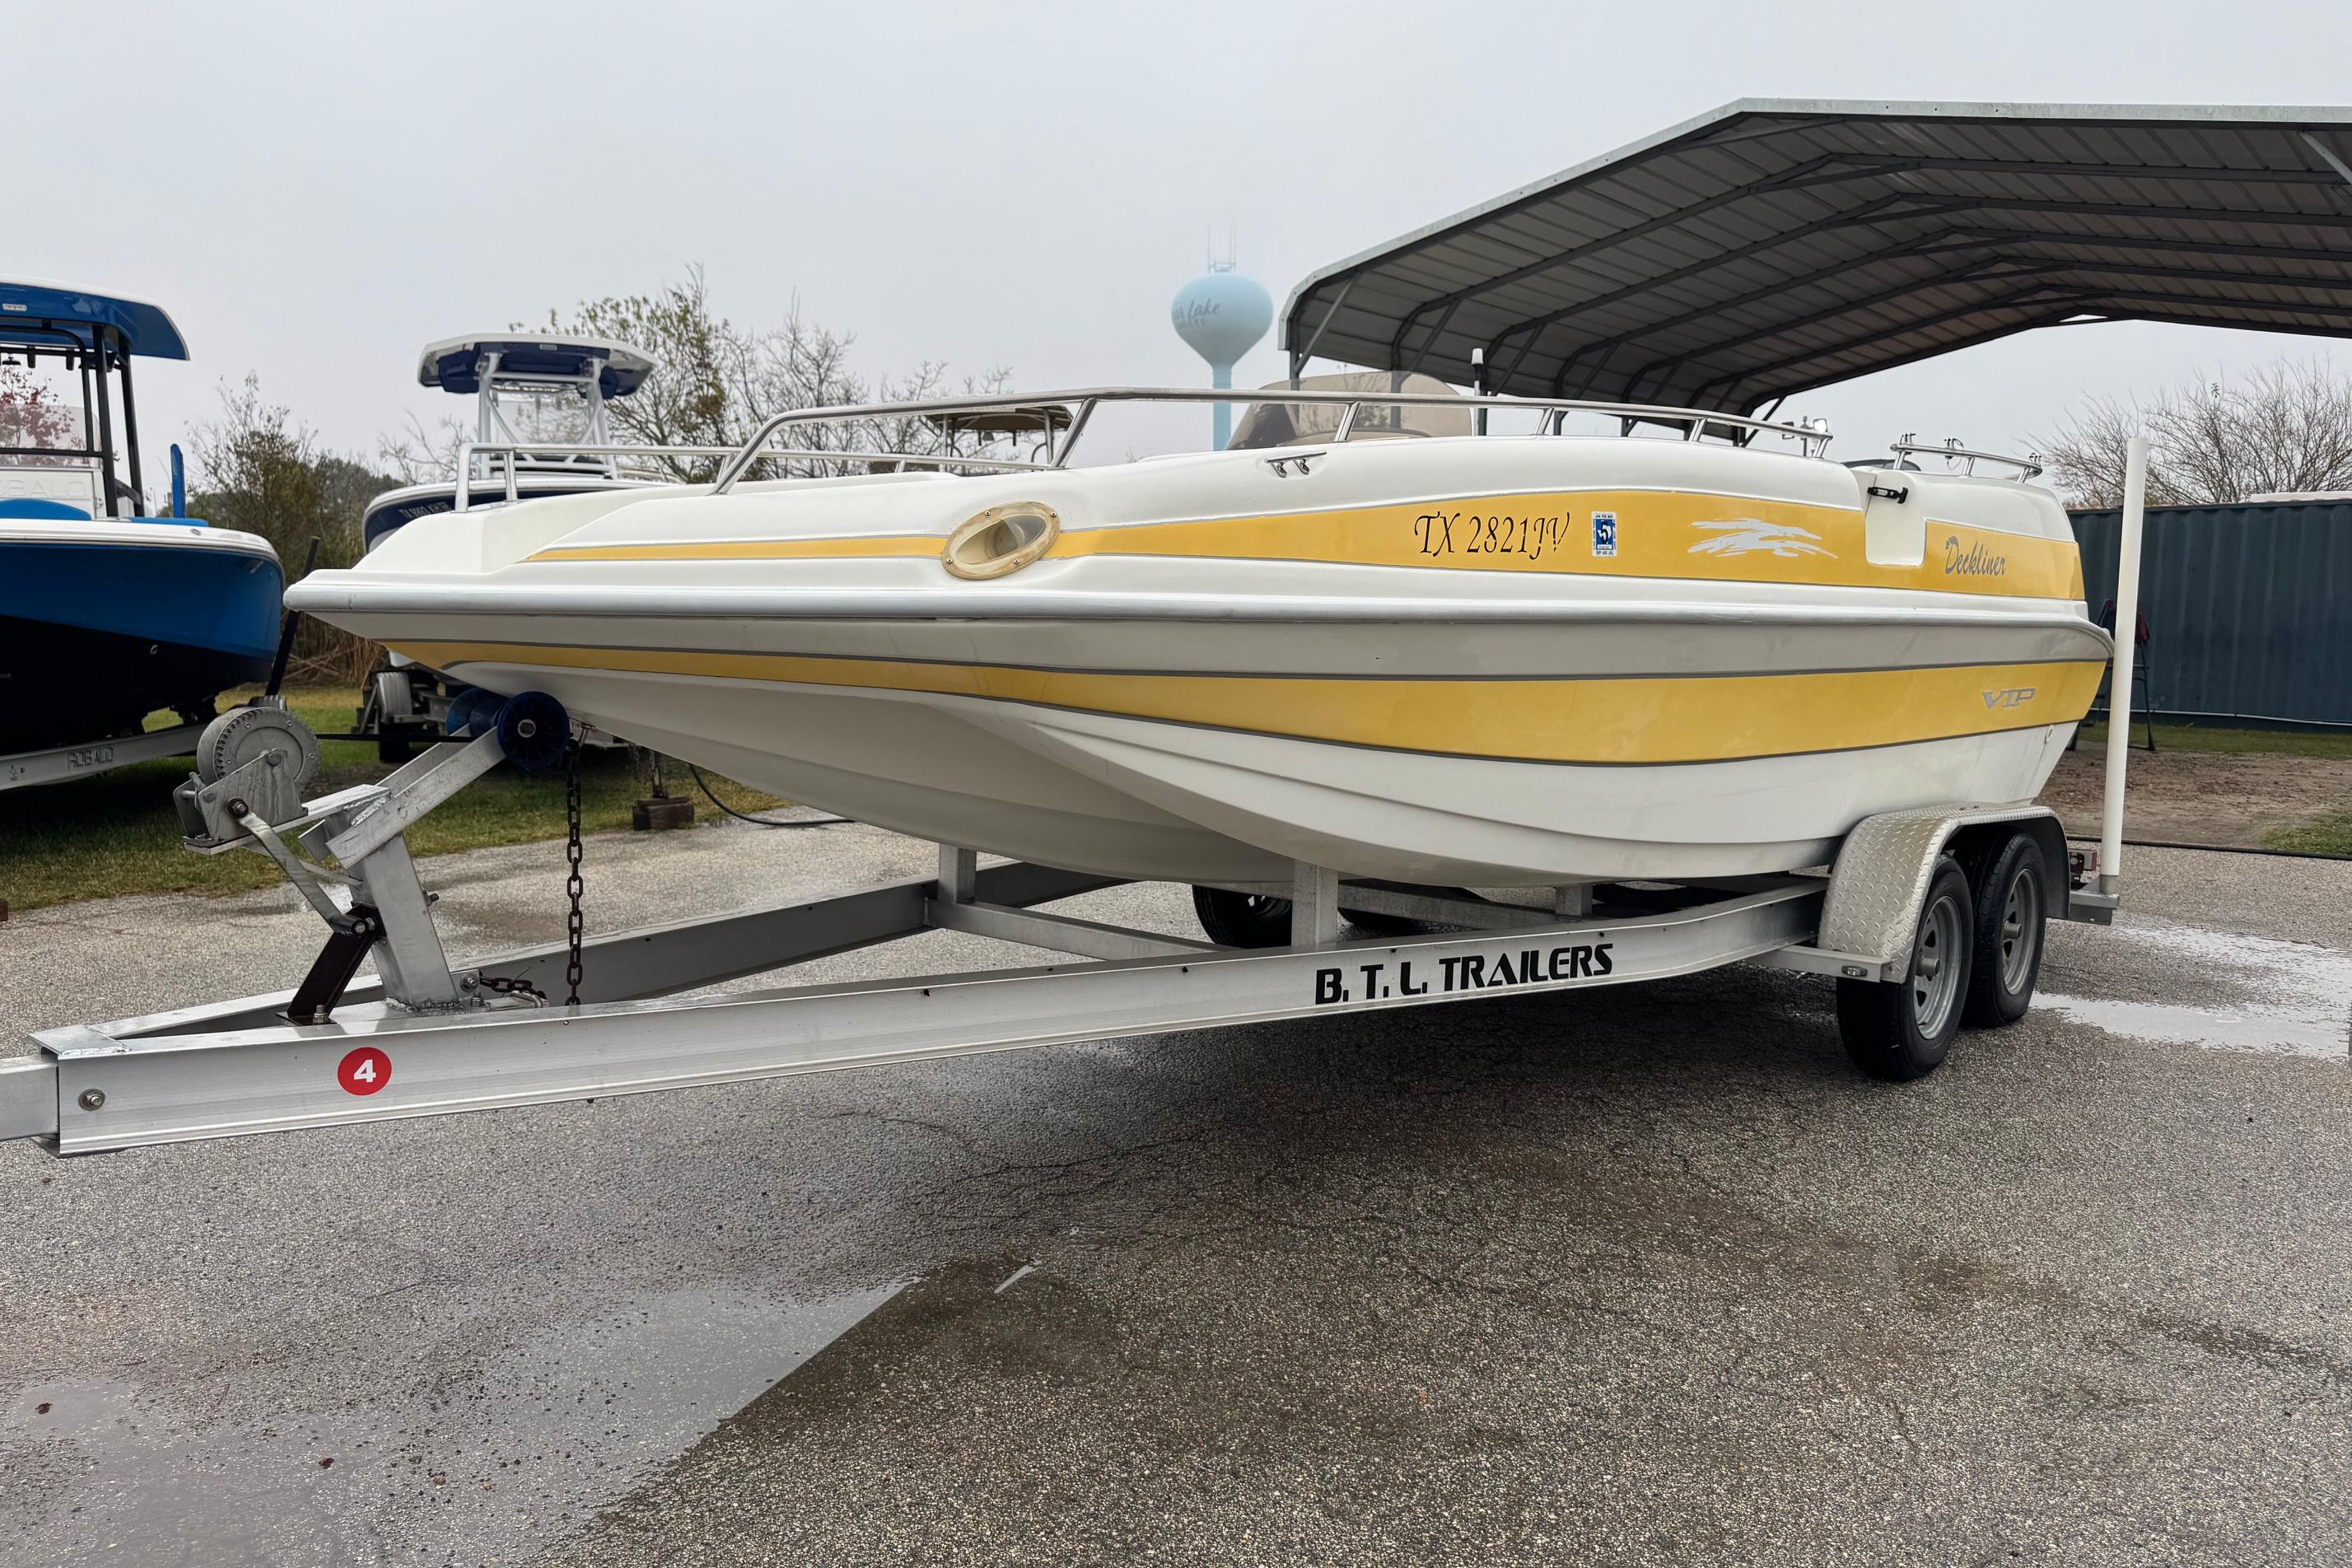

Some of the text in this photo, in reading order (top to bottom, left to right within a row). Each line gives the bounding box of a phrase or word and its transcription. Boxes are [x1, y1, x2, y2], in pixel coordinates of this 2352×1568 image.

[0, 479, 86, 497] BALO
[1414, 511, 1461, 558] TX
[1466, 511, 1570, 560] 2821JV
[1944, 535, 2006, 576] Deckliner
[1981, 688, 2037, 709] VIP
[67, 746, 114, 772] ROBALO
[1438, 942, 1614, 992] TRAILERS
[353, 1058, 377, 1084] 4
